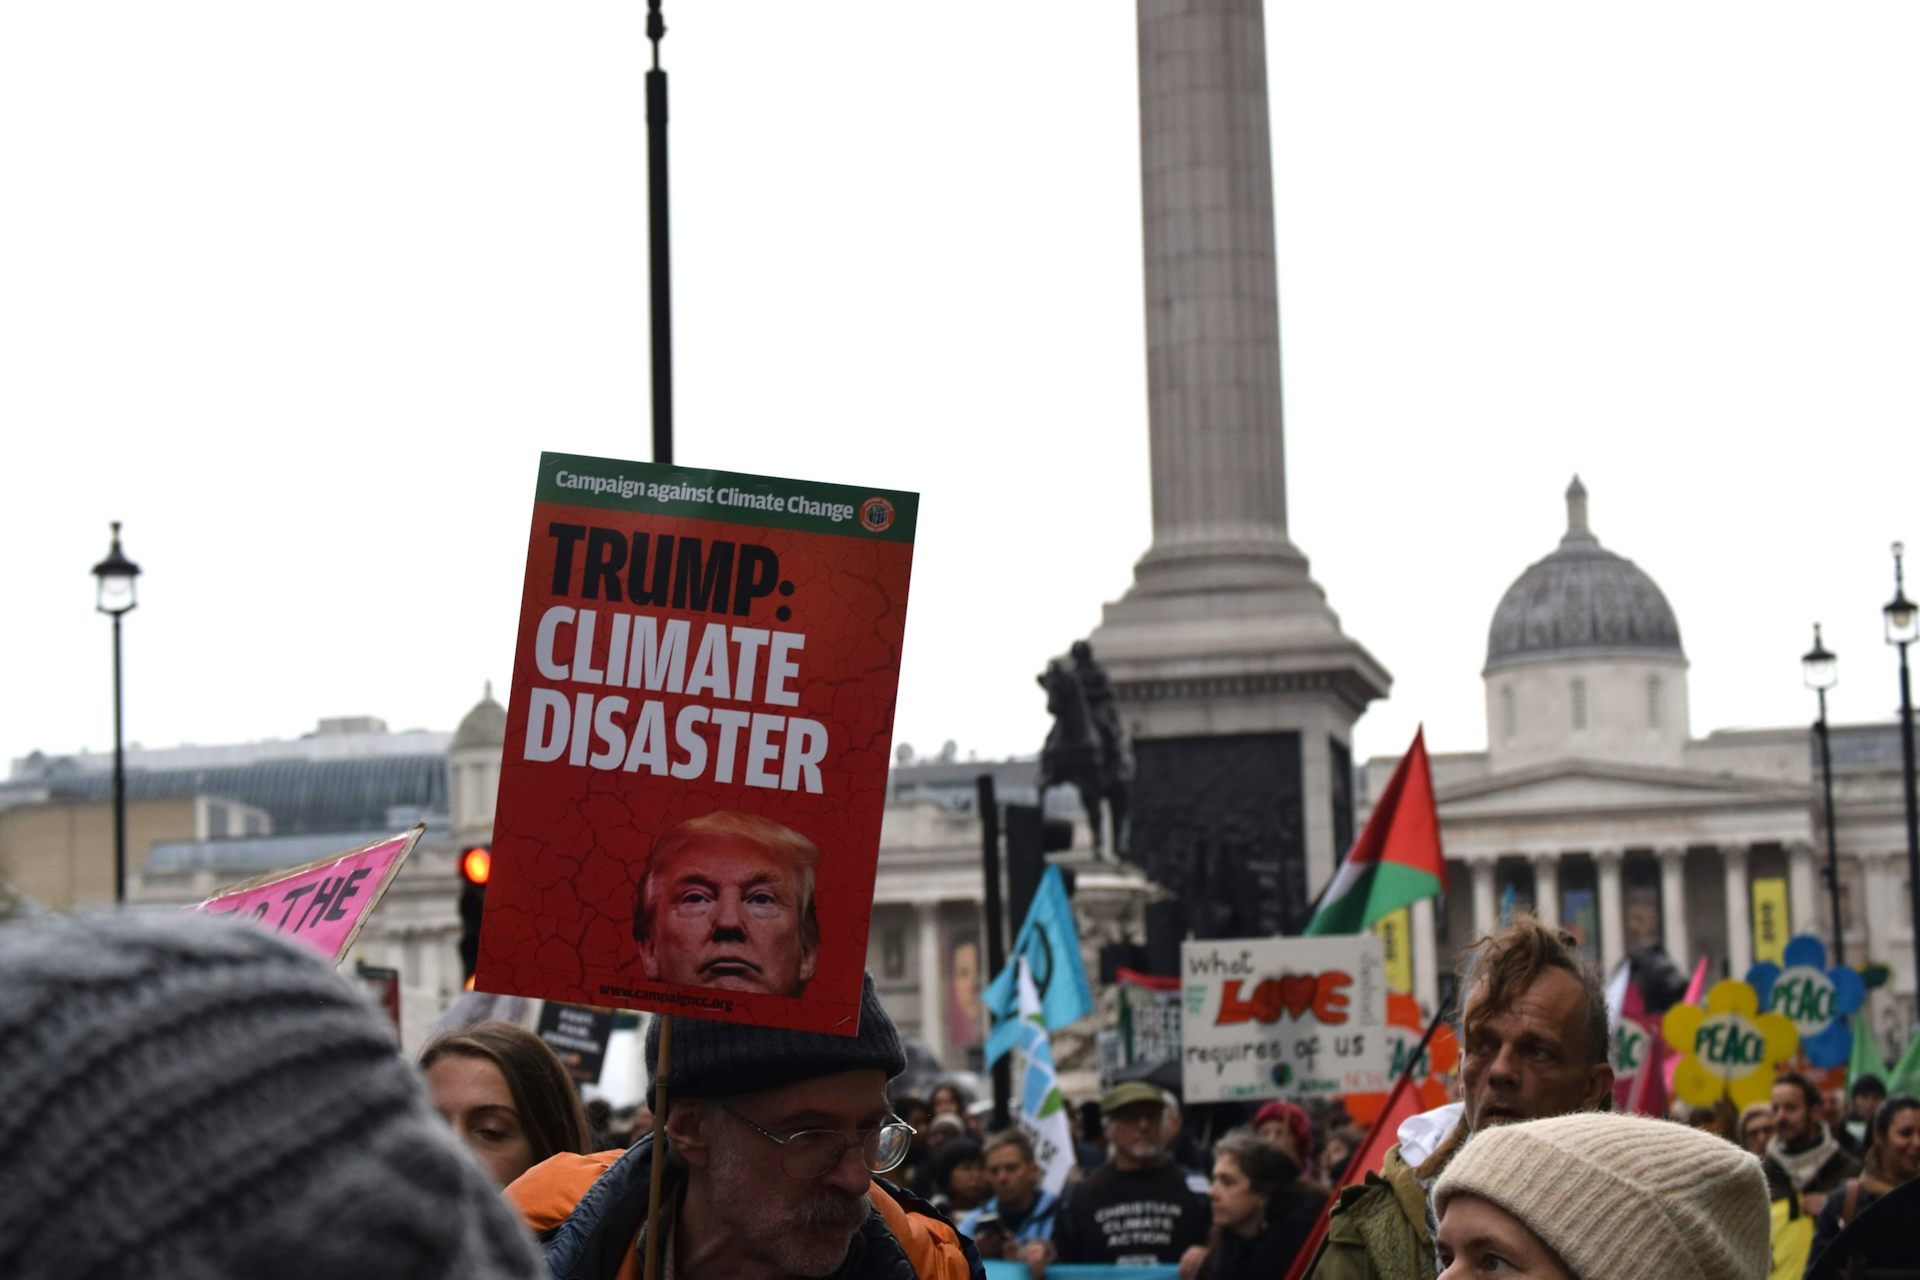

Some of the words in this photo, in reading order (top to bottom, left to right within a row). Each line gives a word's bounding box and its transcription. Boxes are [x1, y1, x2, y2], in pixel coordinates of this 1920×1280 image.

[555, 470, 646, 499] Campaign
[647, 480, 715, 505] against
[716, 487, 785, 512] Climate
[787, 495, 855, 522] Change
[548, 522, 795, 622] TRUMP:
[535, 605, 806, 707] CLIMATE
[523, 687, 829, 794] DISASTER
[278, 867, 373, 934] THE
[599, 984, 735, 1013] www.campaigncc.org
[1213, 972, 1354, 1028] LOVE
[1187, 1041, 1282, 1077] requires
[1294, 1035, 1320, 1073] of
[1102, 1217, 1174, 1234] CLIMATE
[1107, 1231, 1171, 1247] ACTION
